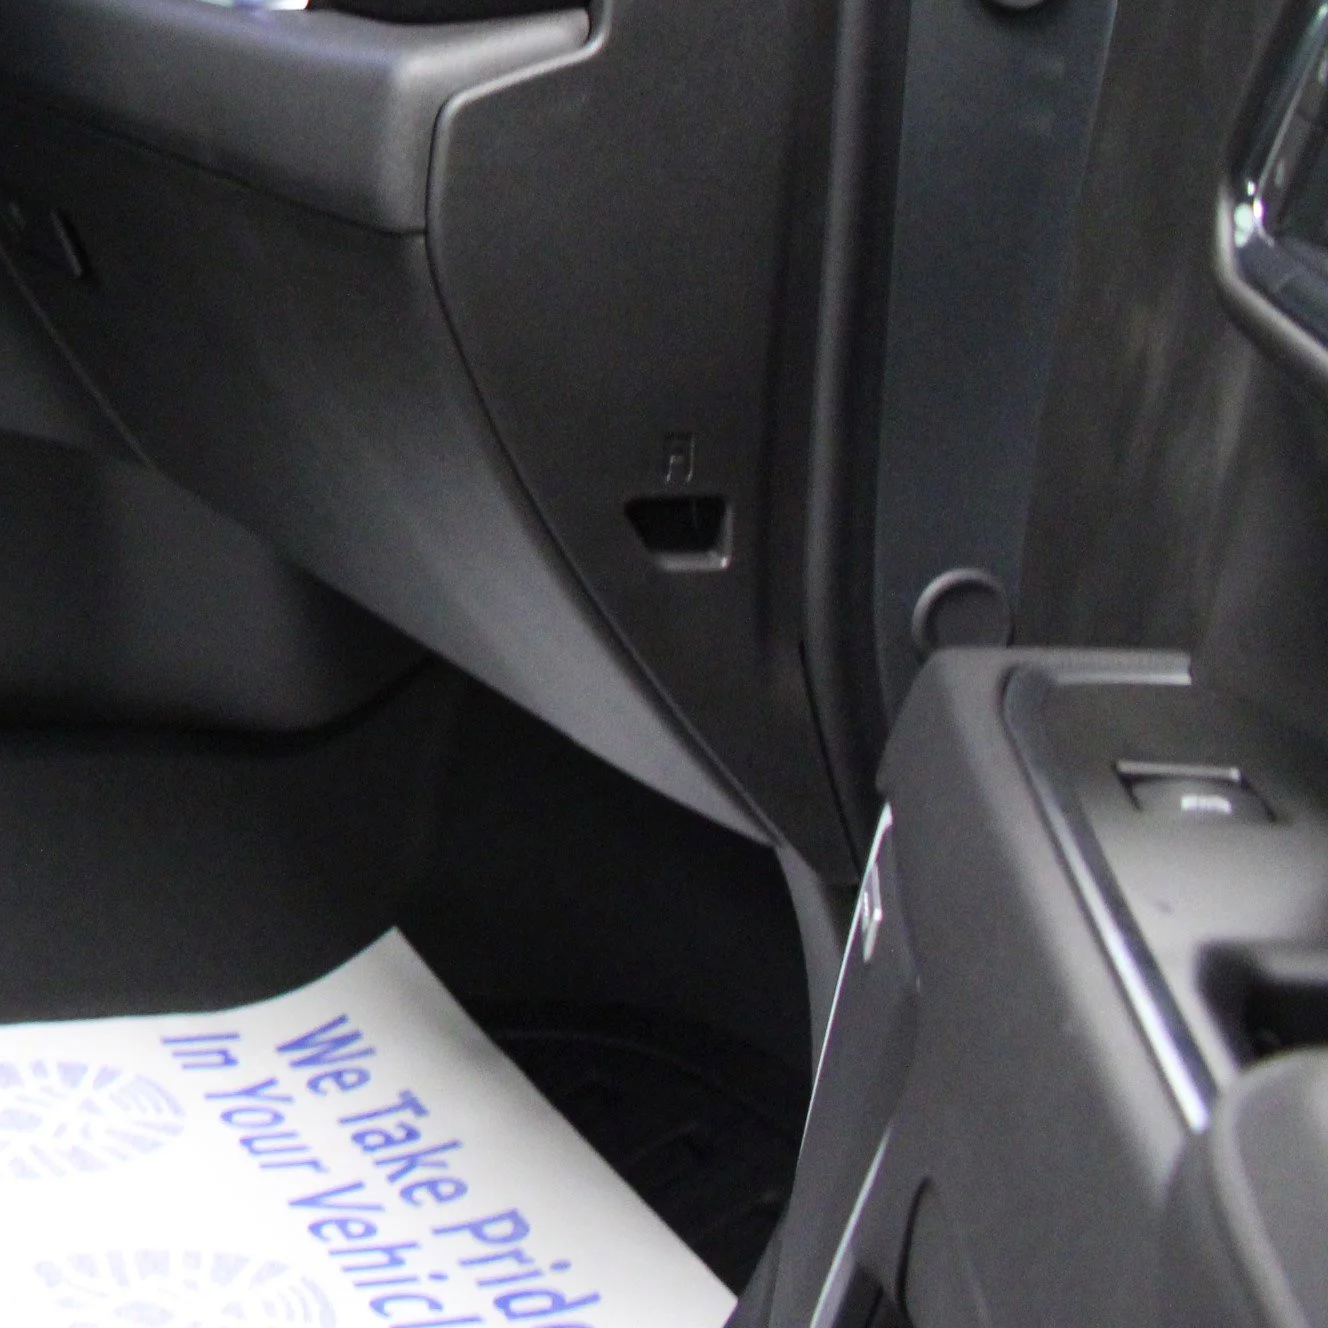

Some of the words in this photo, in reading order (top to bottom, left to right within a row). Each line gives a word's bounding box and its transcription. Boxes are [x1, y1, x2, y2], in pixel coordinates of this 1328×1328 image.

[159, 1031, 241, 1071] In
[203, 1076, 330, 1173] Your
[275, 1013, 377, 1097] We
[338, 1088, 470, 1208] Take
[431, 1207, 602, 1328] Prid
